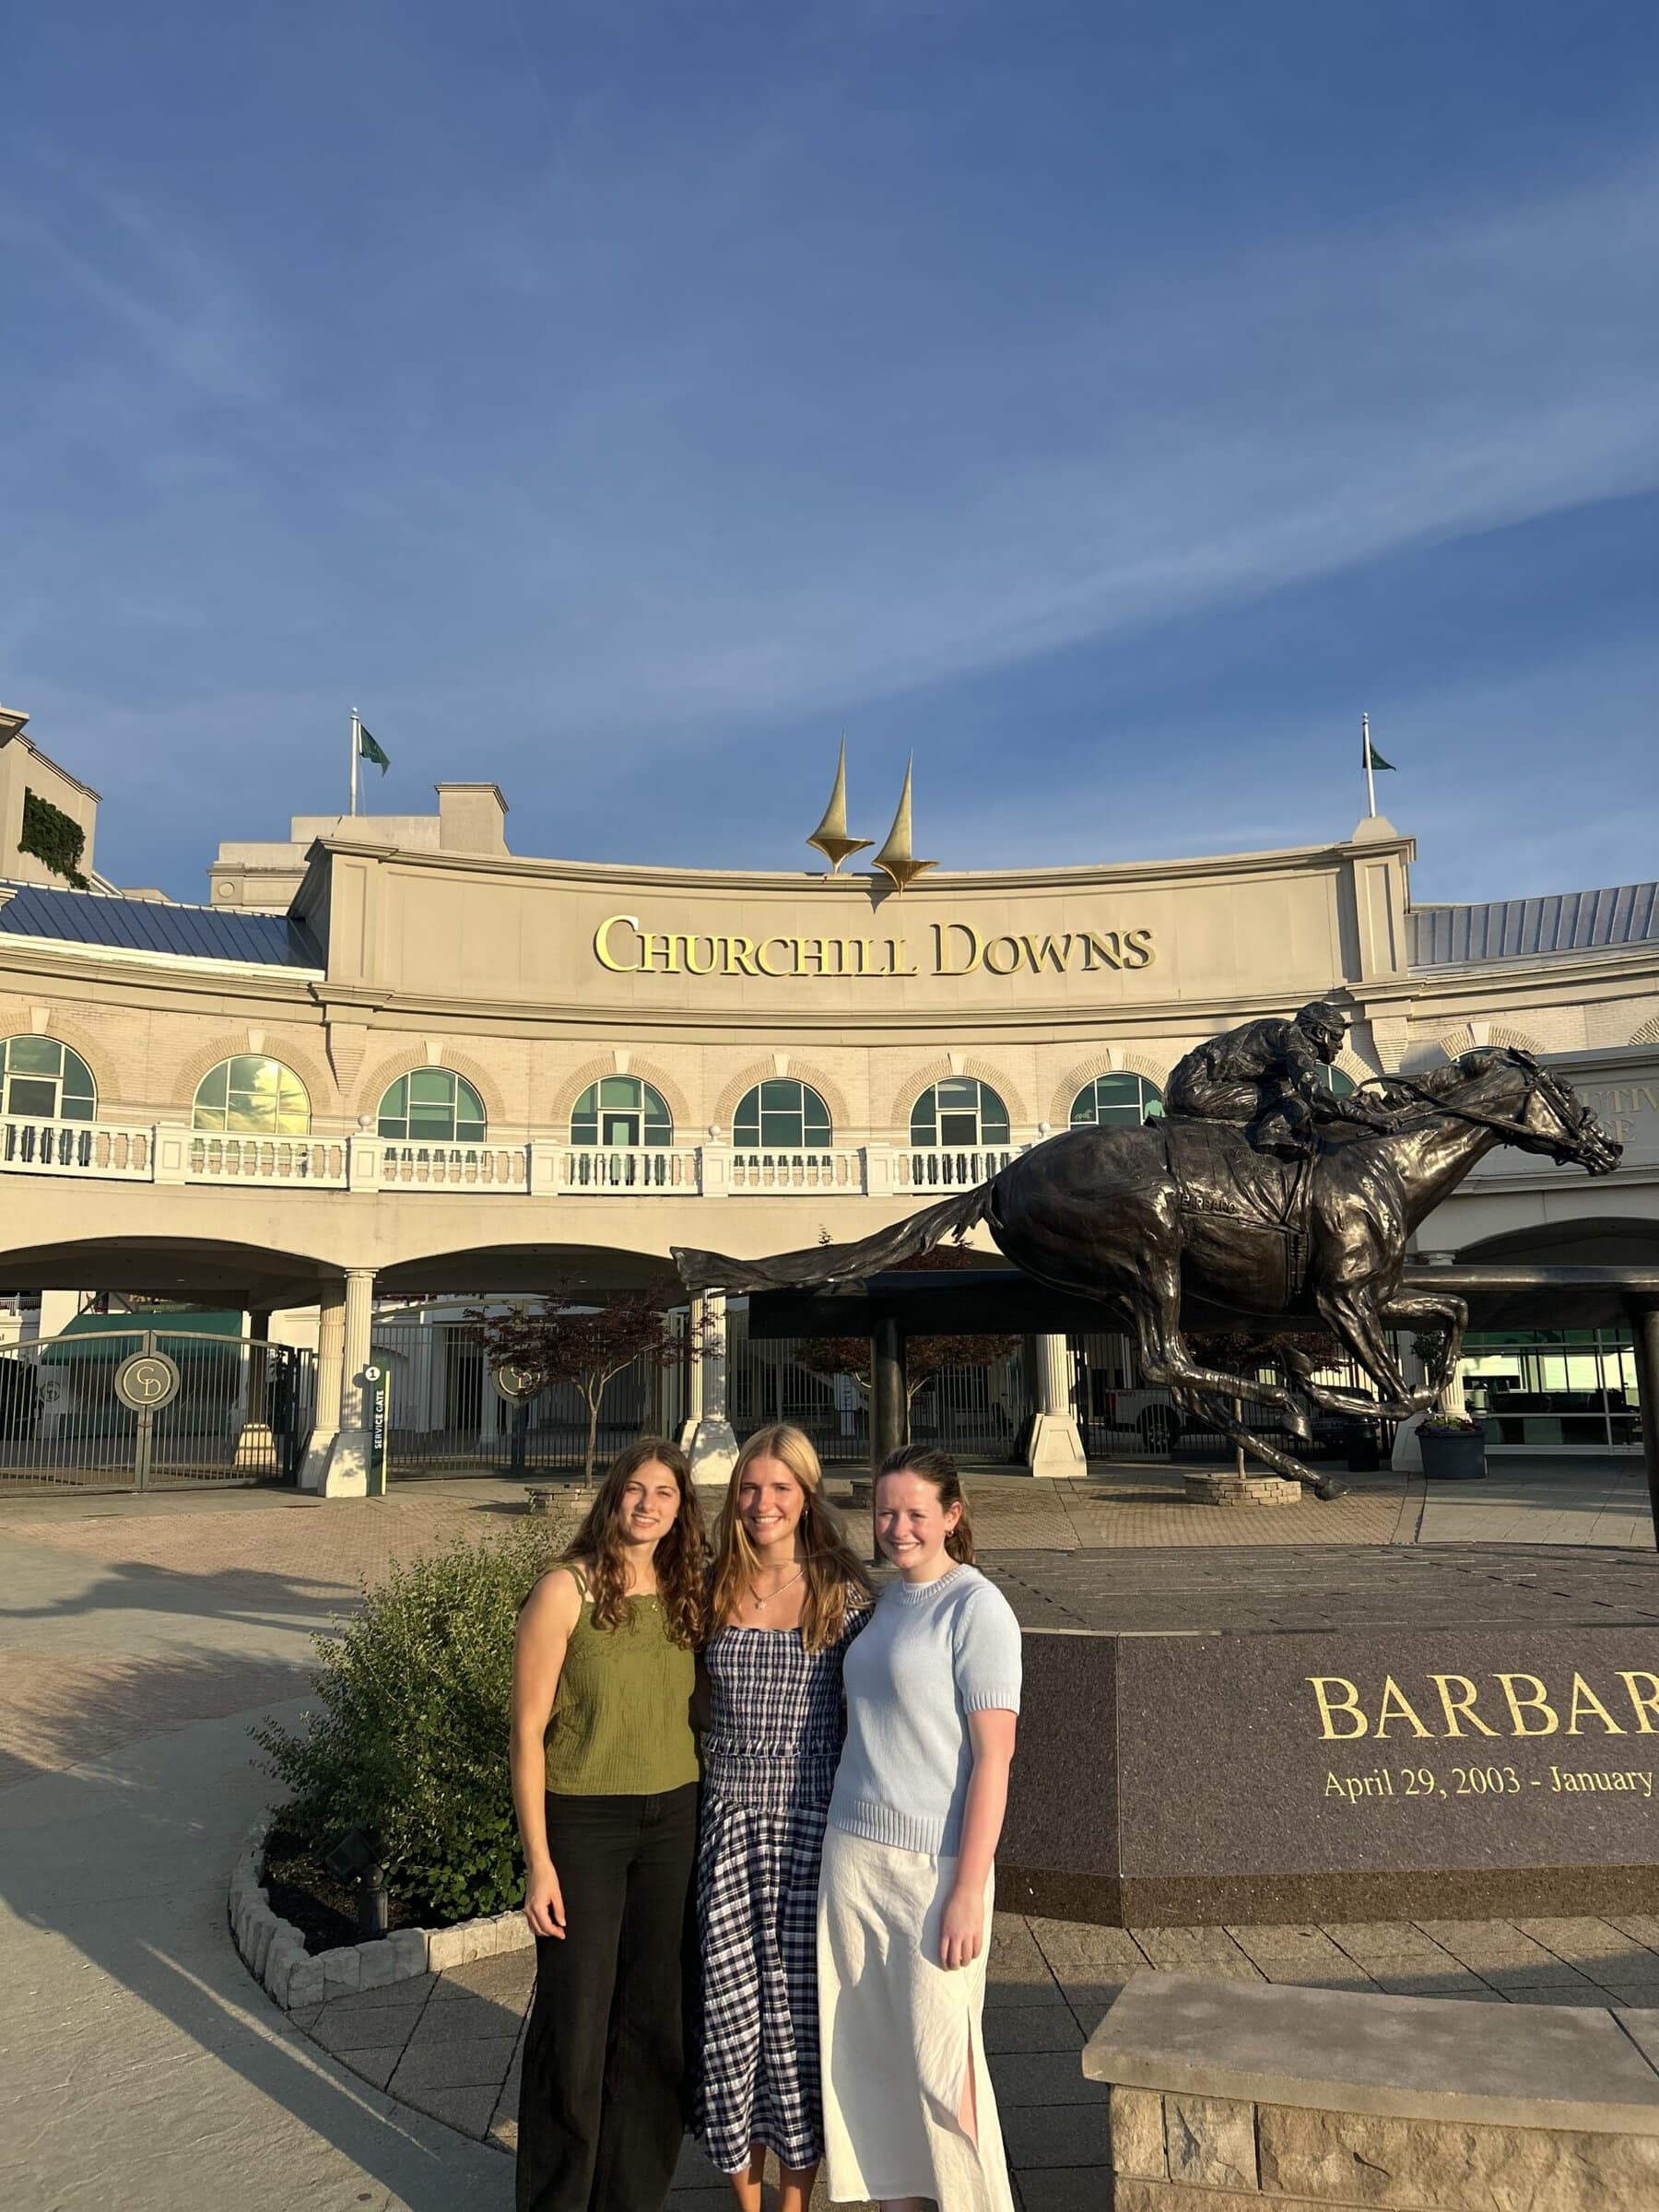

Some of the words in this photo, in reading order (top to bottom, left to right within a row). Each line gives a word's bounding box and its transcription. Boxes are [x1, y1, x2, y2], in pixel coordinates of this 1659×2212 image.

[593, 913, 918, 978] CHURCHILL
[929, 922, 1157, 976] DOWNS
[375, 1390, 384, 1412] GATE
[374, 1413, 383, 1449] SERVICE
[1324, 1769, 1394, 1804] April
[1401, 1768, 1448, 1799] 29,
[1452, 1767, 1521, 1794] 2003
[1548, 1766, 1653, 1797] January
